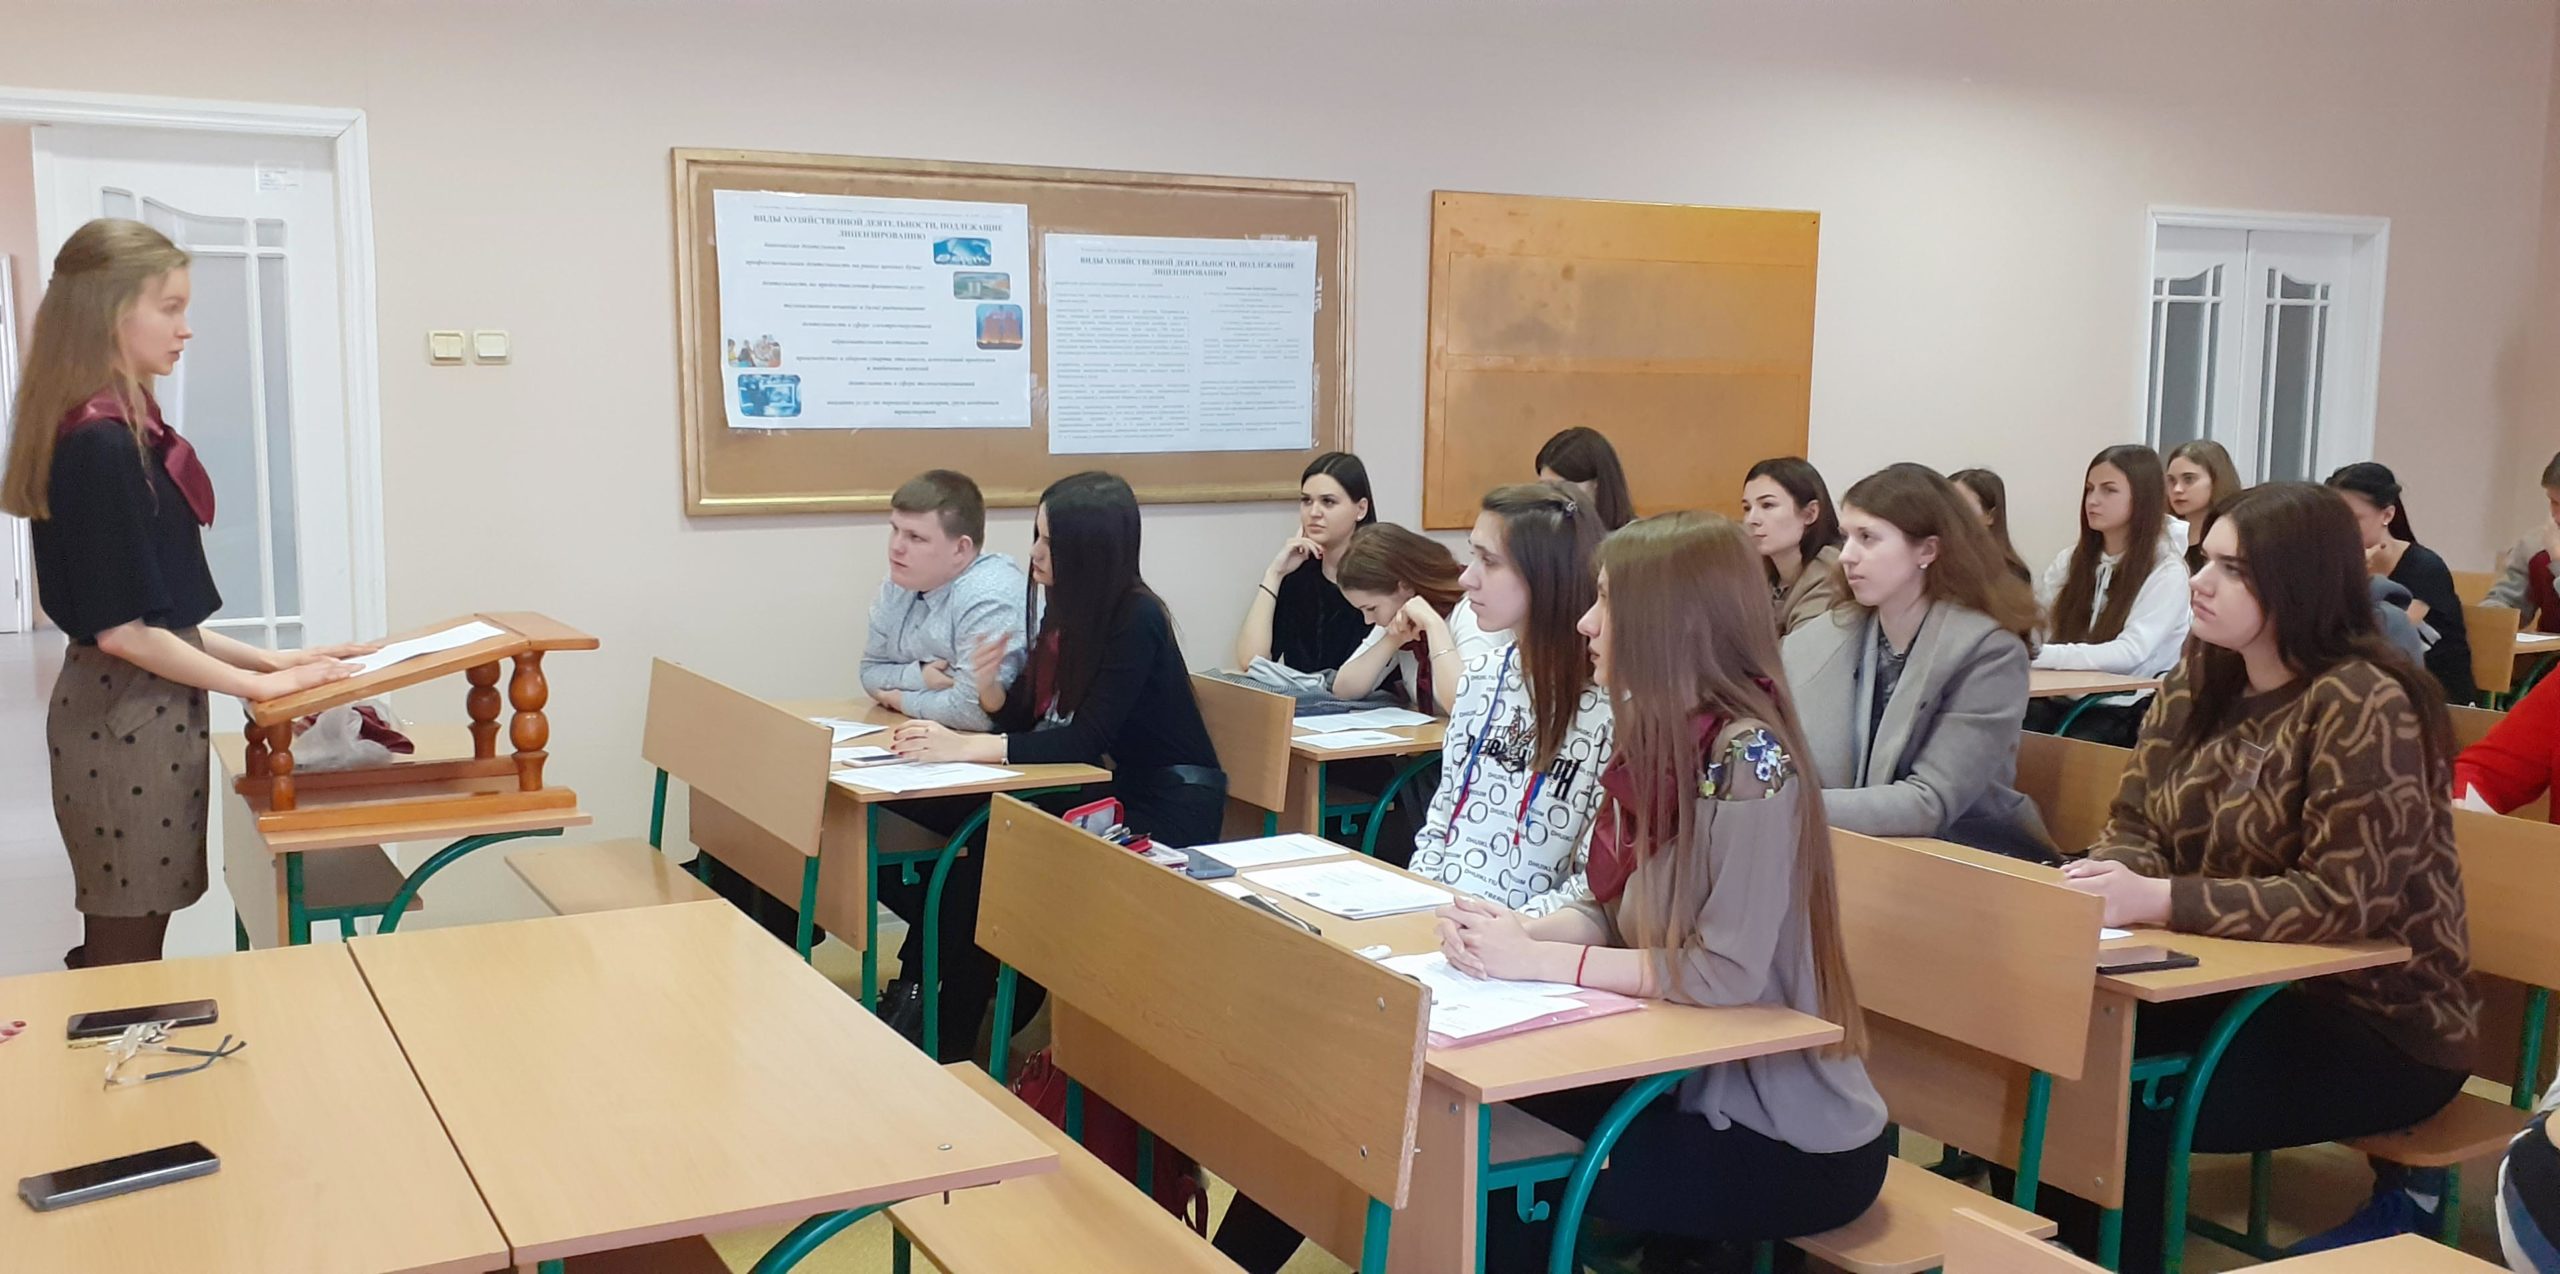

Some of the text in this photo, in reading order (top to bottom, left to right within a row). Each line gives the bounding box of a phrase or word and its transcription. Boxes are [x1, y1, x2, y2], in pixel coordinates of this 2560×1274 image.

[753, 214, 781, 224] ВИДЫ
[784, 215, 863, 226] ХОЗЯЙСТВЕННОЙ
[1080, 256, 1104, 265] ВИДЫ
